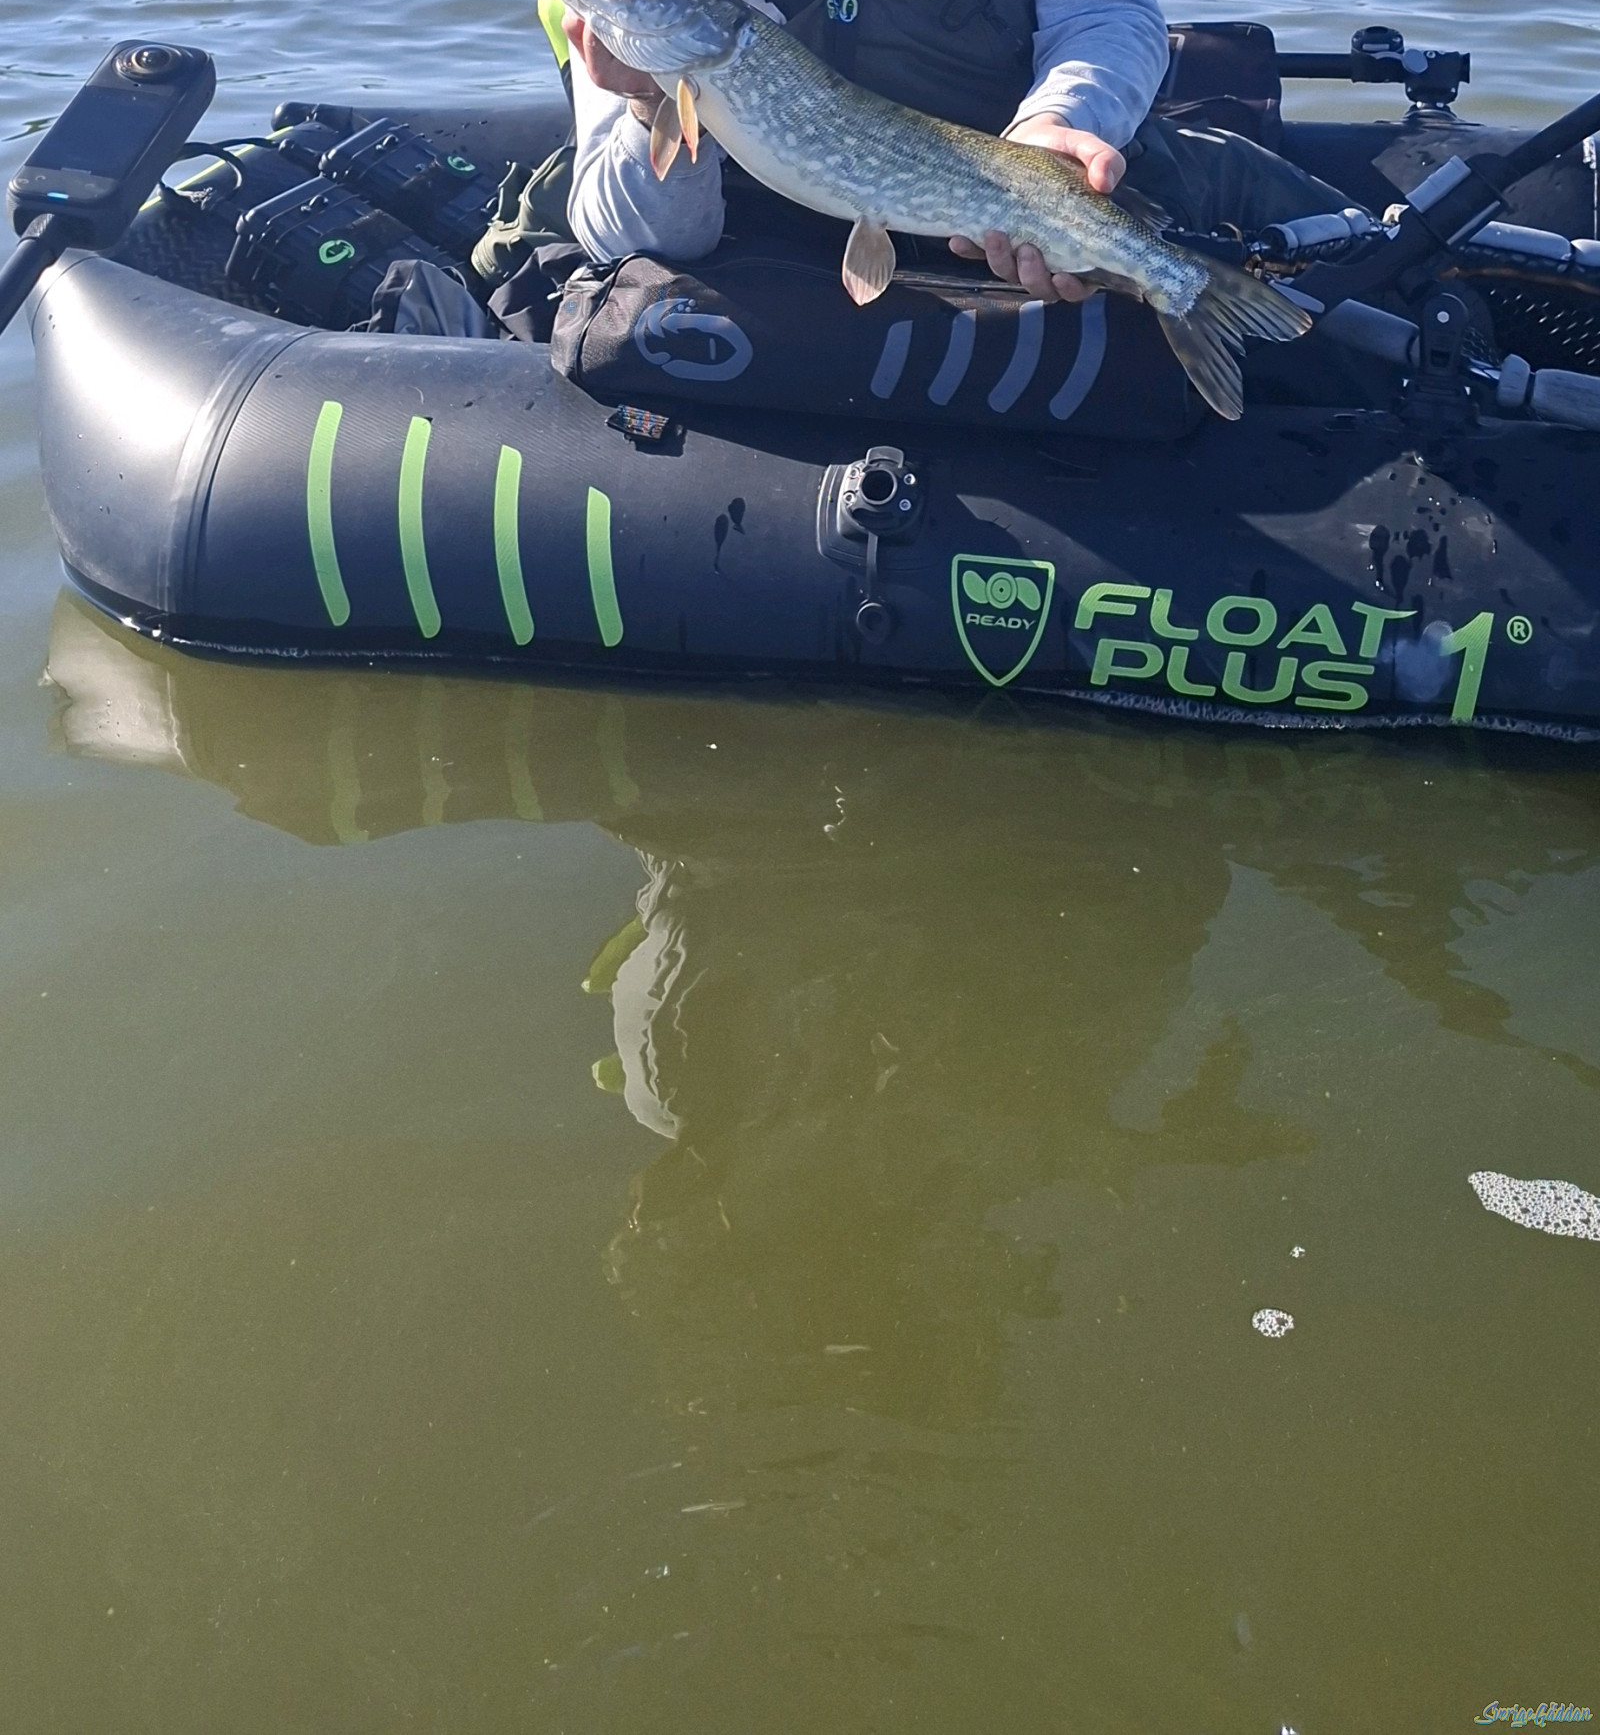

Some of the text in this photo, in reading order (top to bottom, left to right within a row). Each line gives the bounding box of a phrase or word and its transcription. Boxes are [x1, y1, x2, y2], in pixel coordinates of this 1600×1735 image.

[966, 613, 1036, 630] READY
[1074, 582, 1418, 658] FLOAT
[1090, 638, 1375, 711] PLUS
